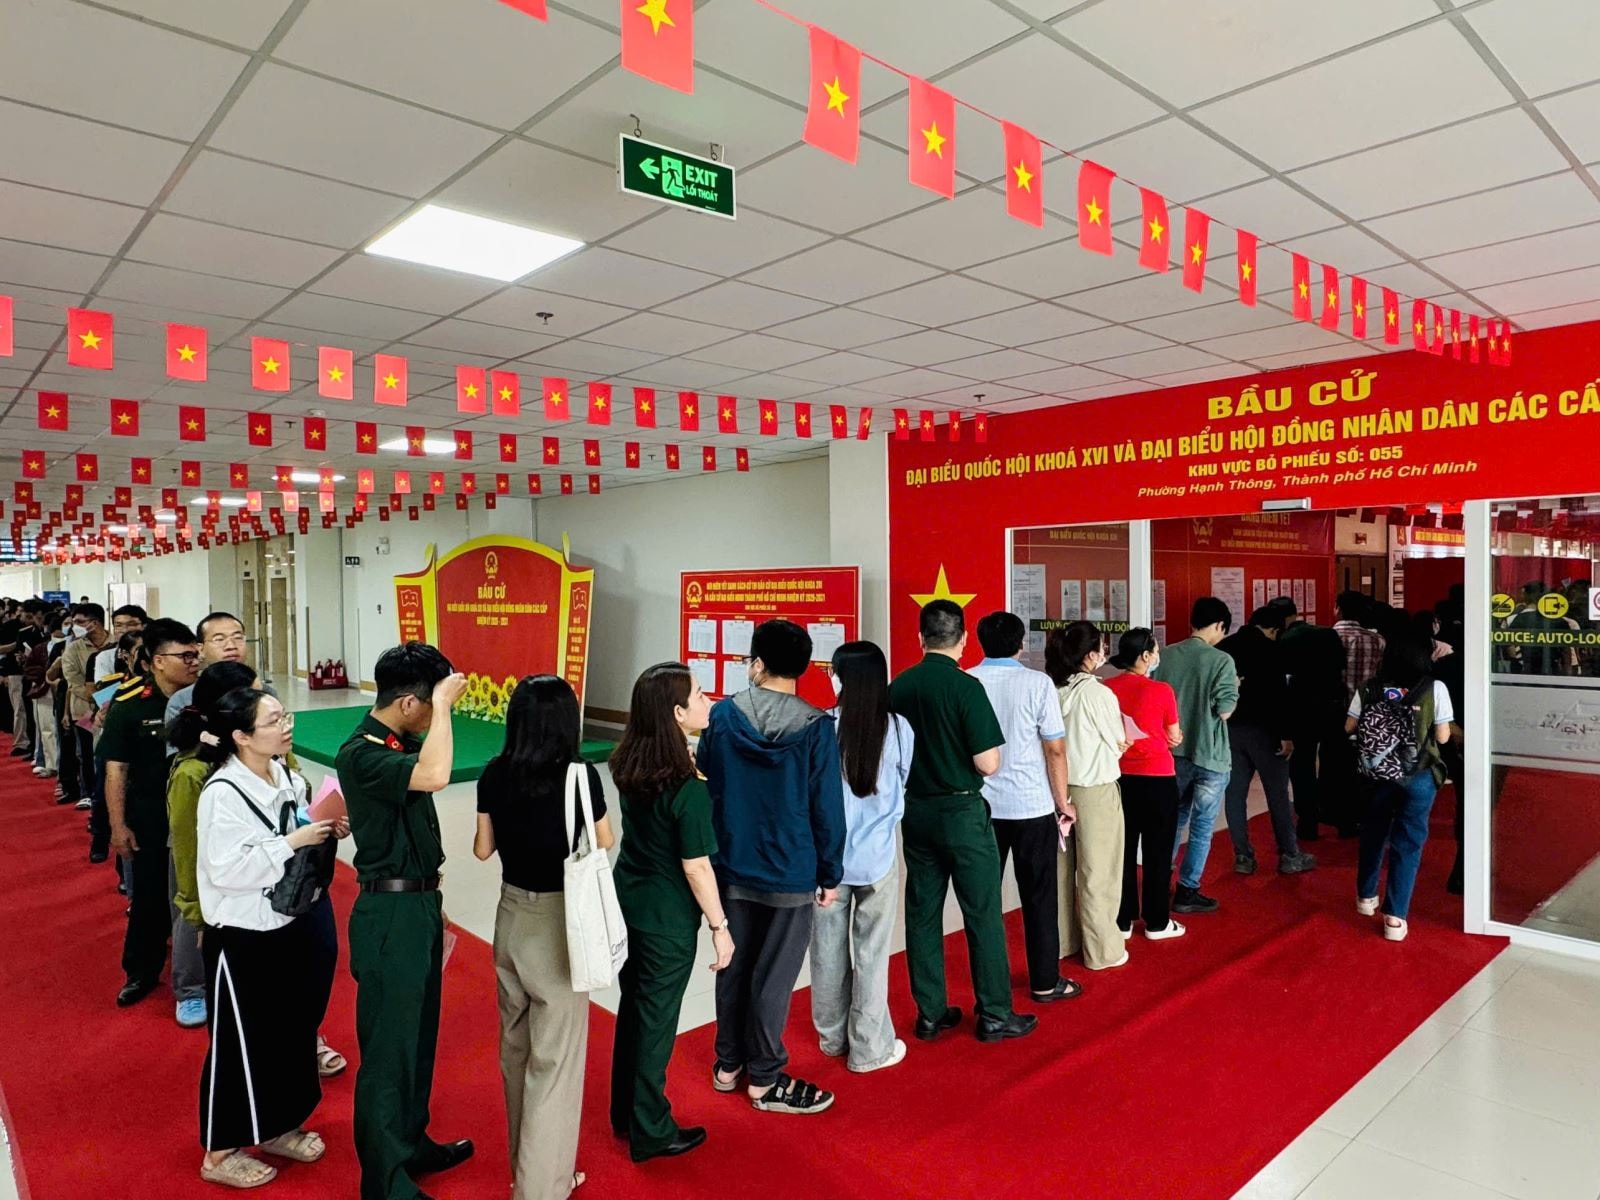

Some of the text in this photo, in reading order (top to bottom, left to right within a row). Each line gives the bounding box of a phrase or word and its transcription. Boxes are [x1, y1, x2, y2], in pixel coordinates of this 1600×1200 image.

[685, 164, 718, 188] EXIT
[685, 183, 718, 202] LỐI THOÁT
[1208, 368, 1378, 420] BẦU CỬ
[906, 378, 1600, 488] ĐẠI BIỂU QUỐC HỘI KHOÁ XVI VÀ ĐẠI BIỂU HỘI ĐỒNG NHÂN DÂN CÁC CẤ
[1188, 445, 1403, 477] KHU VỰC BỎ PHIẾU SỐ: 055
[1137, 485, 1186, 497] Phường
[1189, 481, 1224, 495] Hạnh
[1229, 476, 1276, 491] Thông,
[1282, 471, 1329, 485] Thành
[1333, 466, 1368, 485] phố
[1397, 463, 1429, 478] Chí
[1432, 460, 1478, 475] Minh
